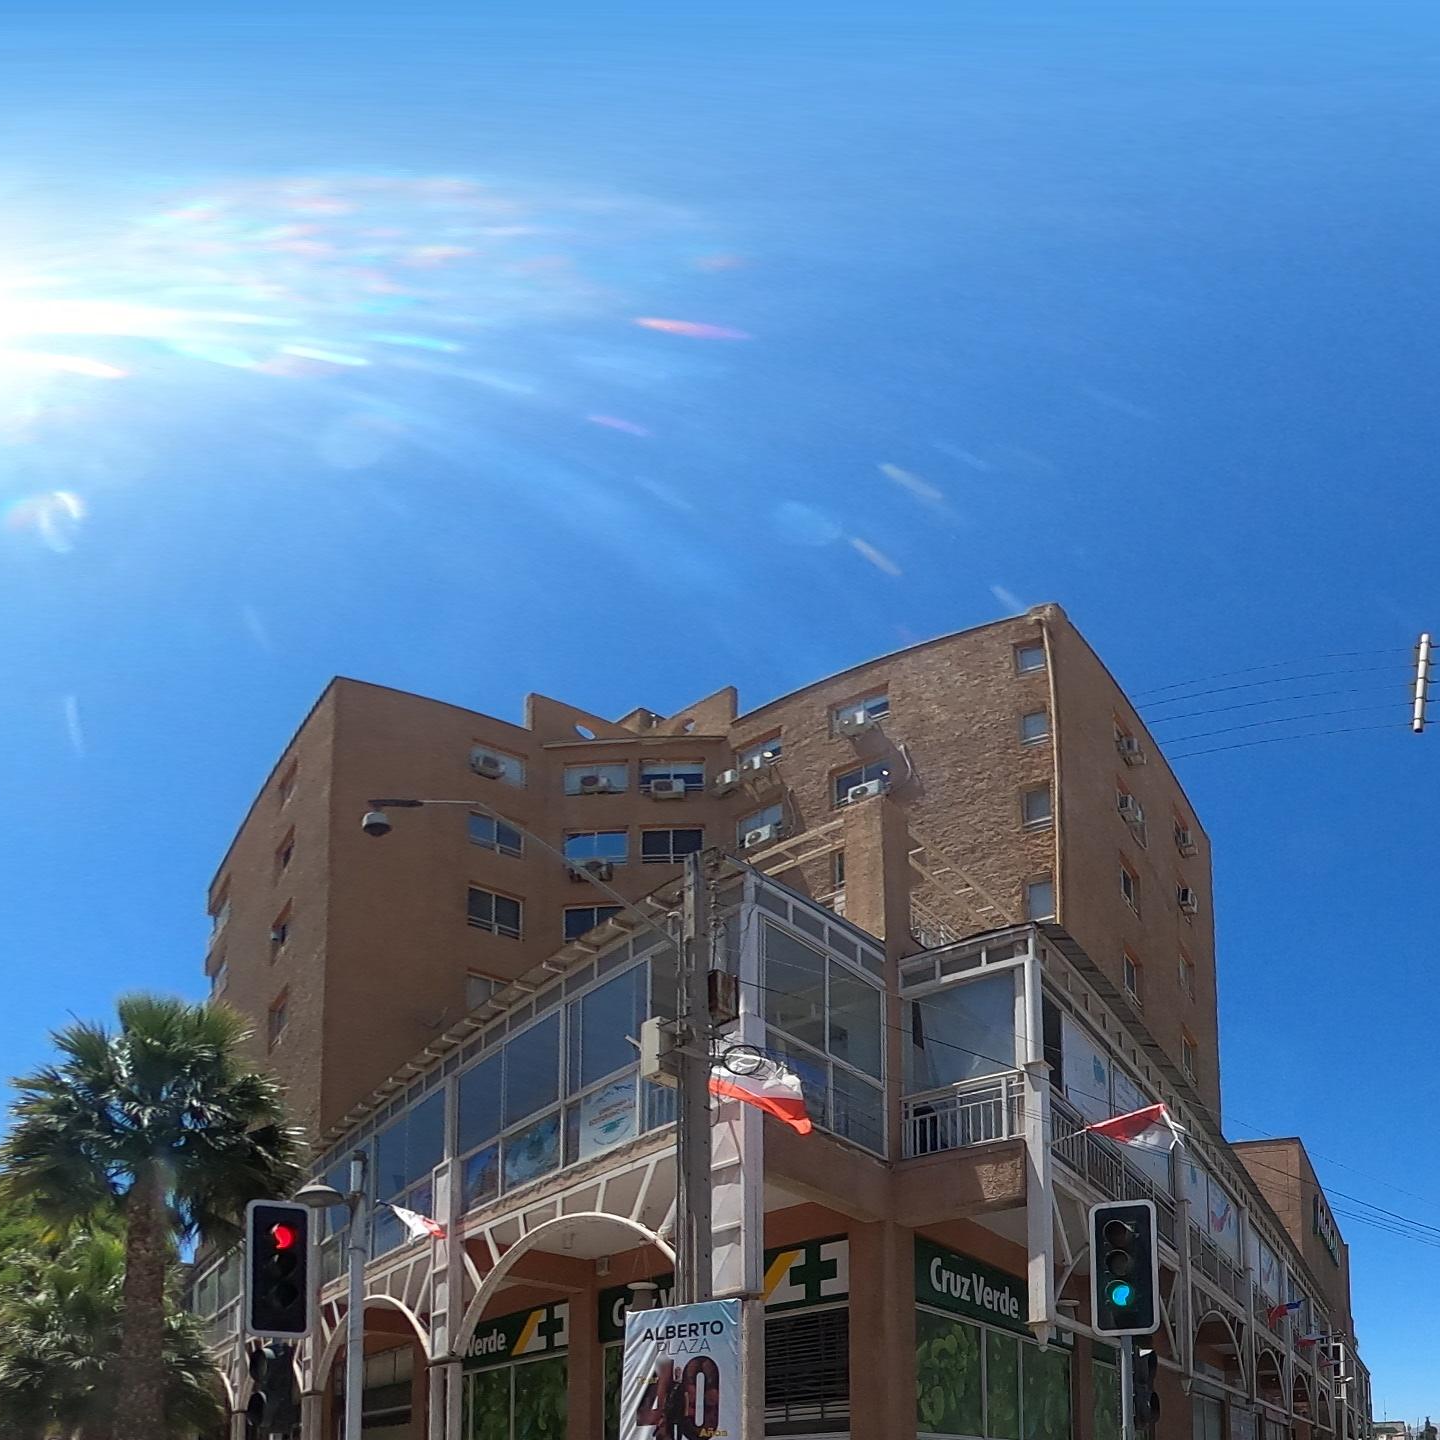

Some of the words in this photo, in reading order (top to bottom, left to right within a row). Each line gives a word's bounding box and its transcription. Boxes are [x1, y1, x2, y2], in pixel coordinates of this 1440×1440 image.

[930, 1257, 971, 1301] Cruz
[972, 1273, 1020, 1319] Verde
[642, 1320, 724, 1342] ALBERTO
[656, 1338, 712, 1355] PLAZA
